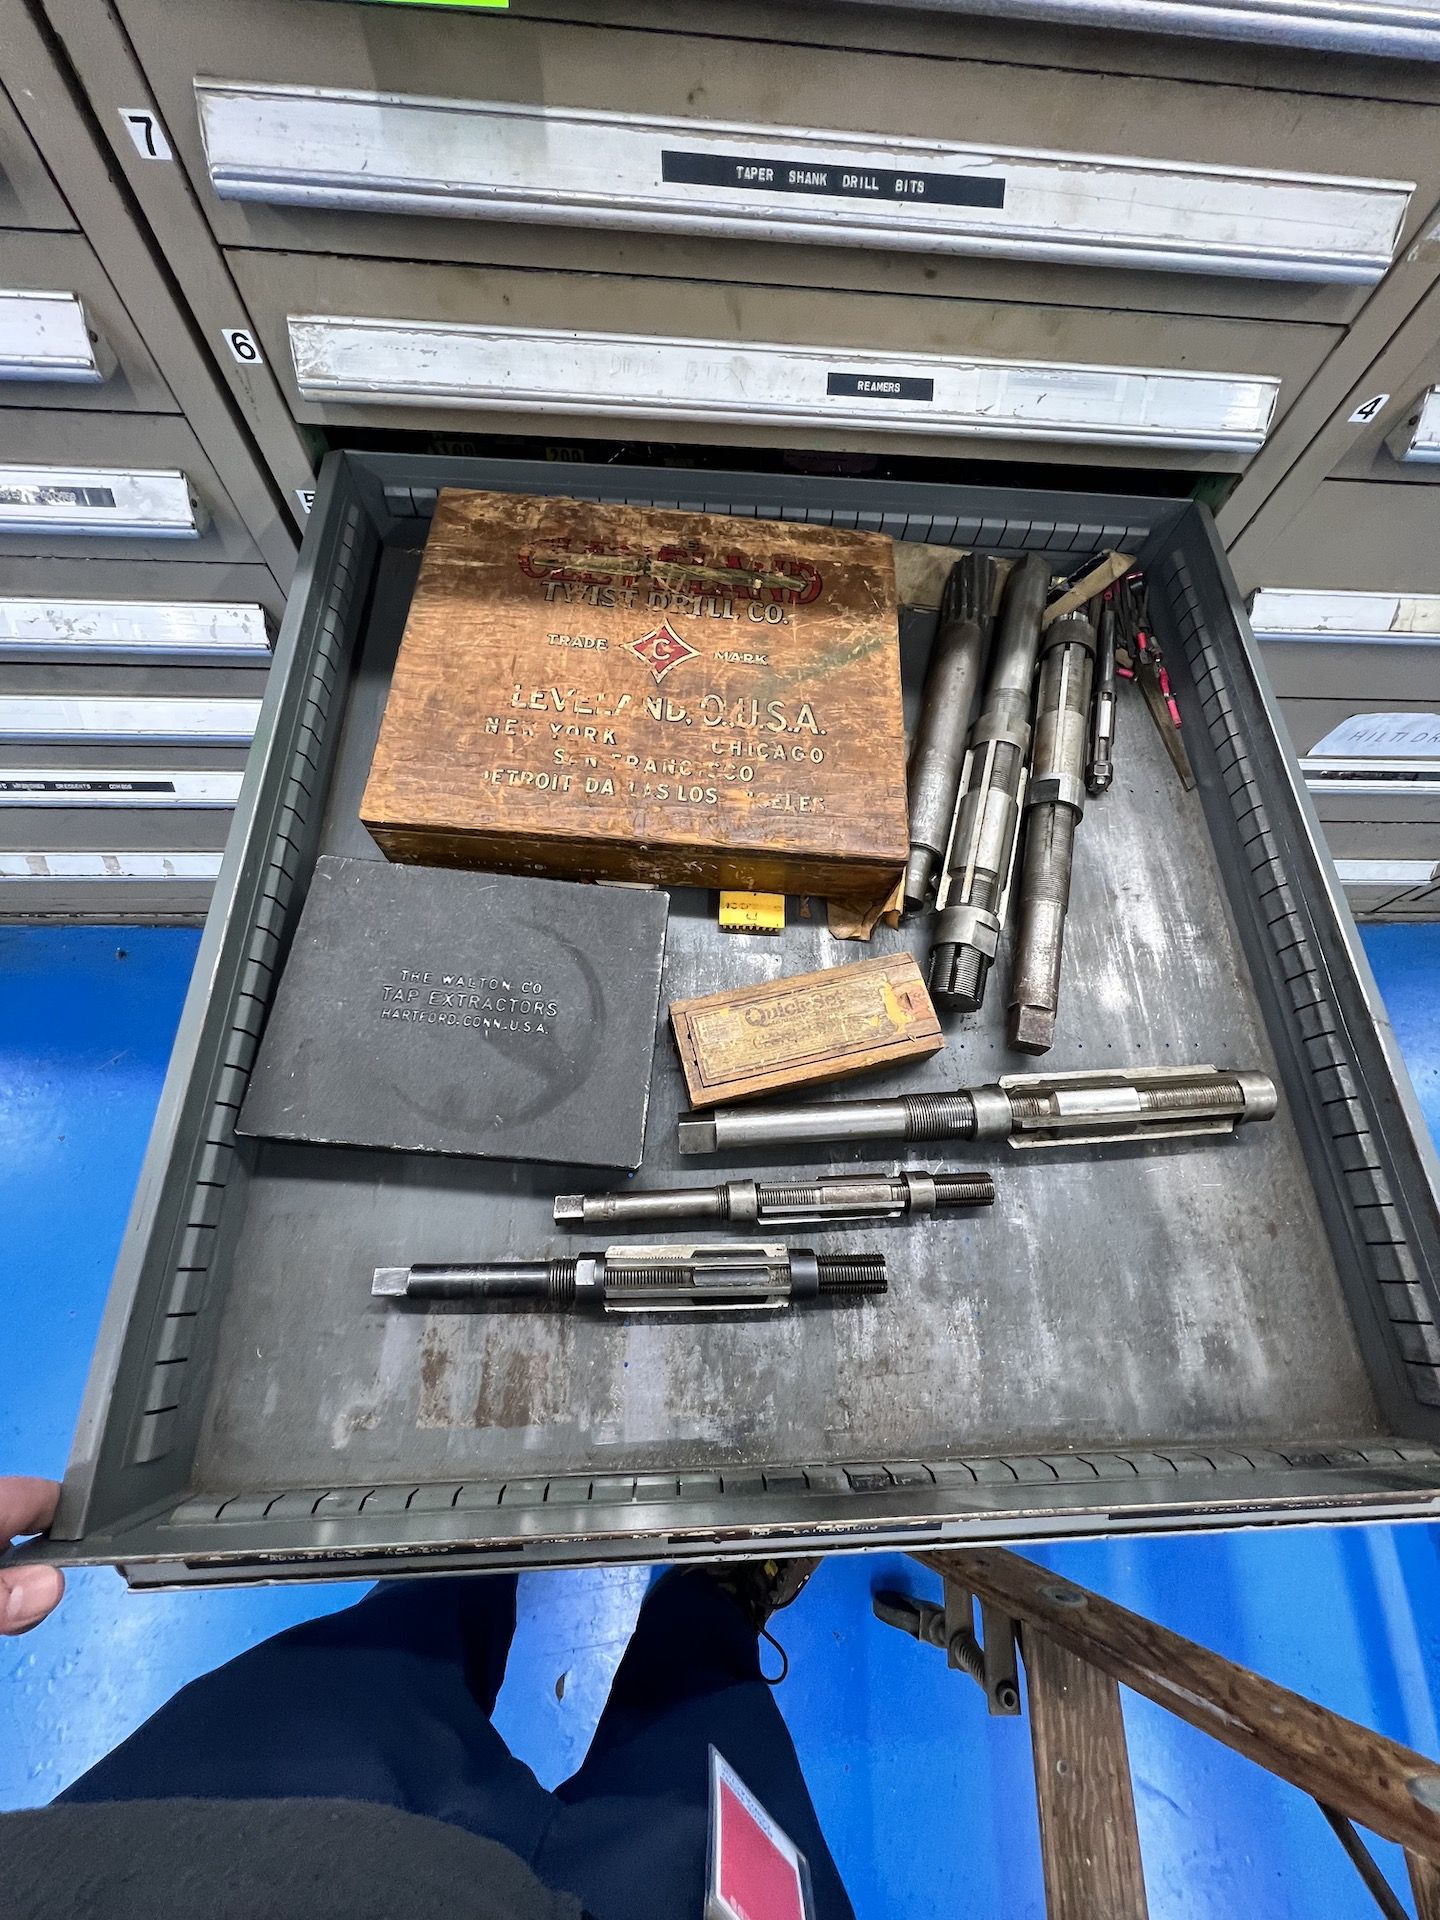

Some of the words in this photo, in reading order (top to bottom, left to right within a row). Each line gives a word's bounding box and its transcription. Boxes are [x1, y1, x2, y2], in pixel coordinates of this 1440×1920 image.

[128, 116, 157, 157] 7
[736, 165, 774, 182] TAPER
[788, 169, 828, 187] SHANK
[842, 174, 879, 191] DRILL
[895, 179, 925, 194] BITS
[230, 332, 257, 360] 6
[857, 380, 901, 393] REAMERS
[1356, 396, 1383, 420] 4
[541, 581, 639, 608] TWIST
[747, 601, 789, 625] CO.
[547, 633, 609, 651] TRADE
[713, 650, 770, 666] MARK
[652, 638, 671, 661] C
[549, 722, 618, 746] YORK
[711, 739, 825, 764] CHICAGO
[676, 784, 719, 805] LOS
[400, 969, 433, 985] THE
[442, 974, 513, 993] WALTON
[382, 985, 420, 1003] TAP
[428, 990, 559, 1018] EXTRACTORS
